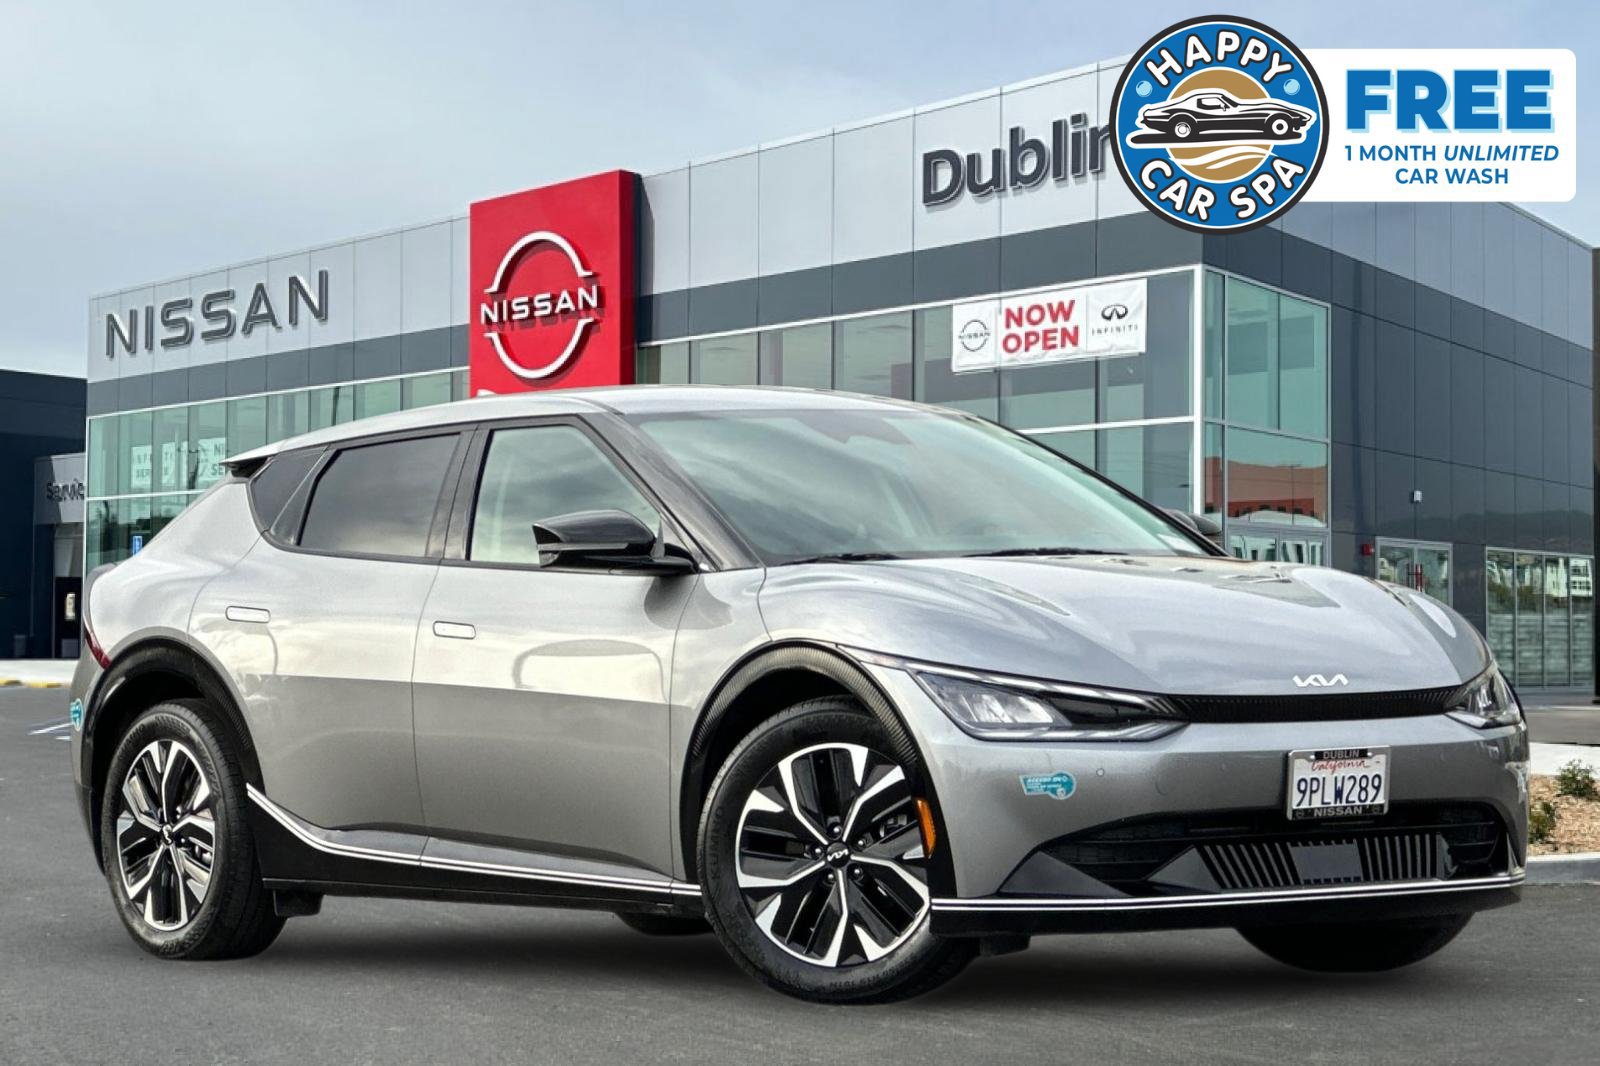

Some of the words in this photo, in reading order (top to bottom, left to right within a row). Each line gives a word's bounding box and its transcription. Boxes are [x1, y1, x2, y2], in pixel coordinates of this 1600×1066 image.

[105, 269, 329, 360] NISSAN
[480, 284, 598, 325] NISSAN
[1004, 299, 1076, 330] NOW
[1002, 325, 1080, 354] OPEN
[1091, 323, 1139, 337] INFINITI
[1292, 673, 1349, 687] KIA
[1322, 749, 1361, 760] DUBLIN
[1311, 759, 1371, 774] California
[1296, 773, 1382, 807] 9PLW289
[1313, 805, 1364, 818] NISSAN
